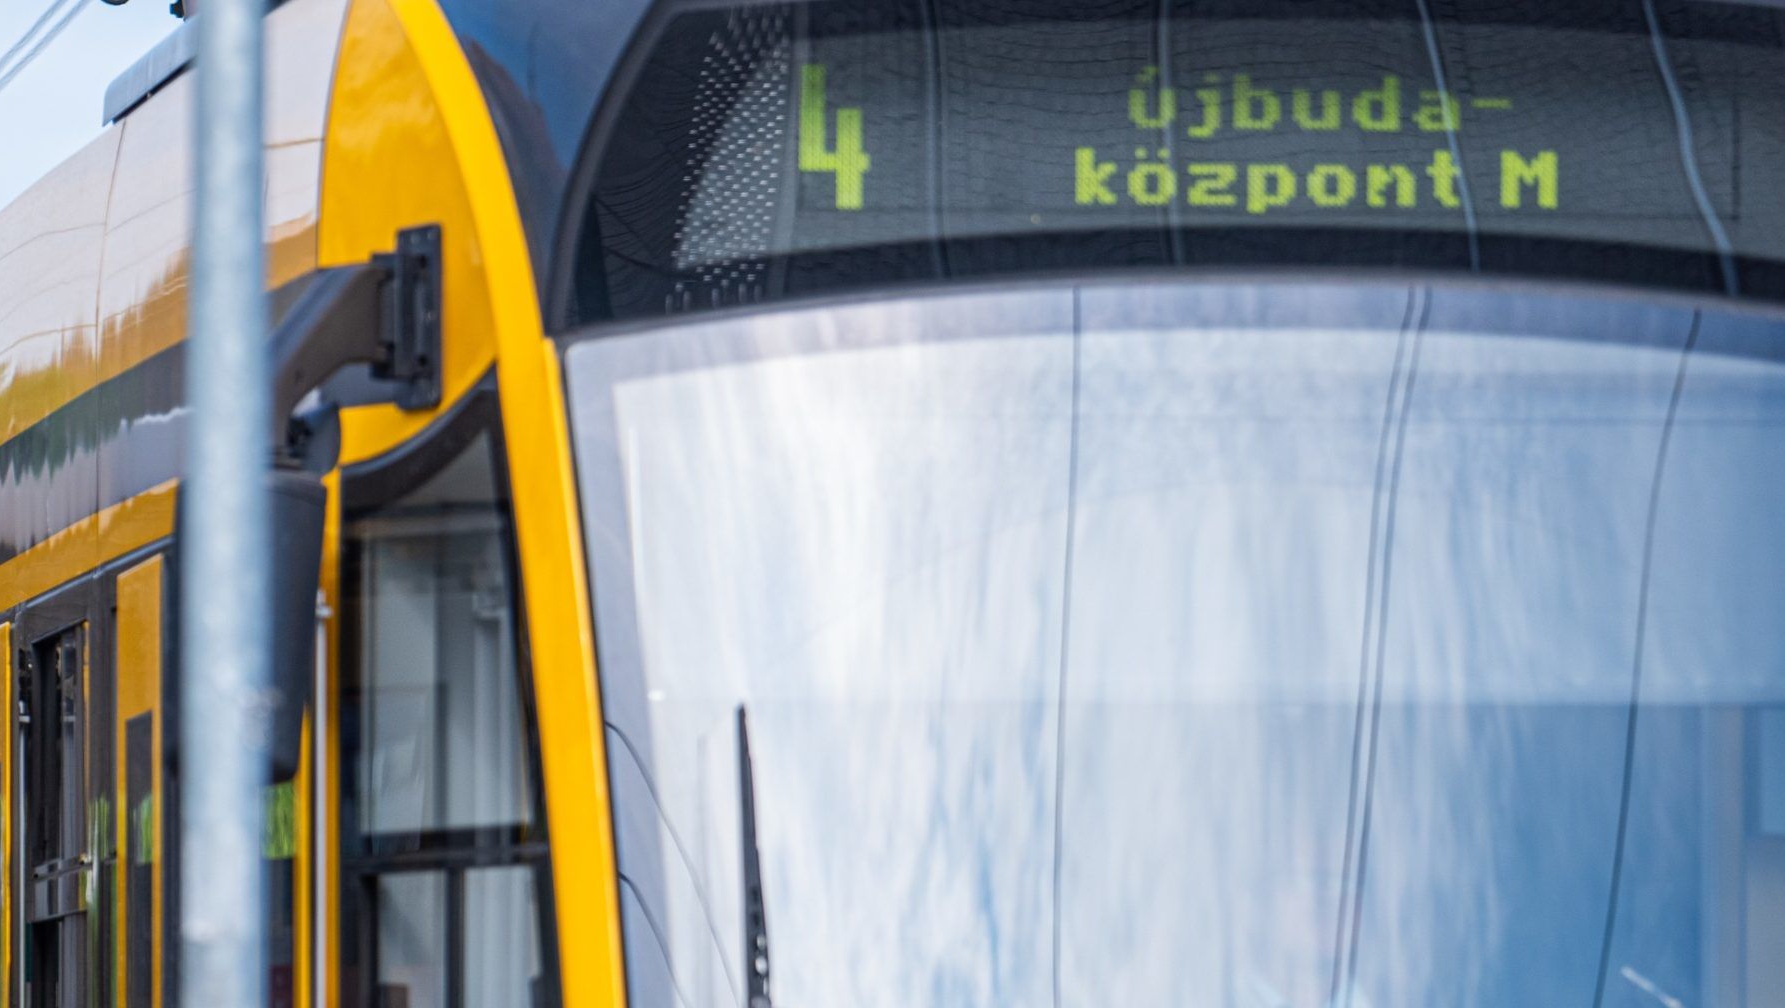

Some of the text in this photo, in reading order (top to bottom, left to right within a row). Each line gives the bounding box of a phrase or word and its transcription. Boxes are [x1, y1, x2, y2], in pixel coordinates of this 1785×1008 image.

[798, 63, 871, 210] 4
[1074, 146, 1559, 213] központ M
